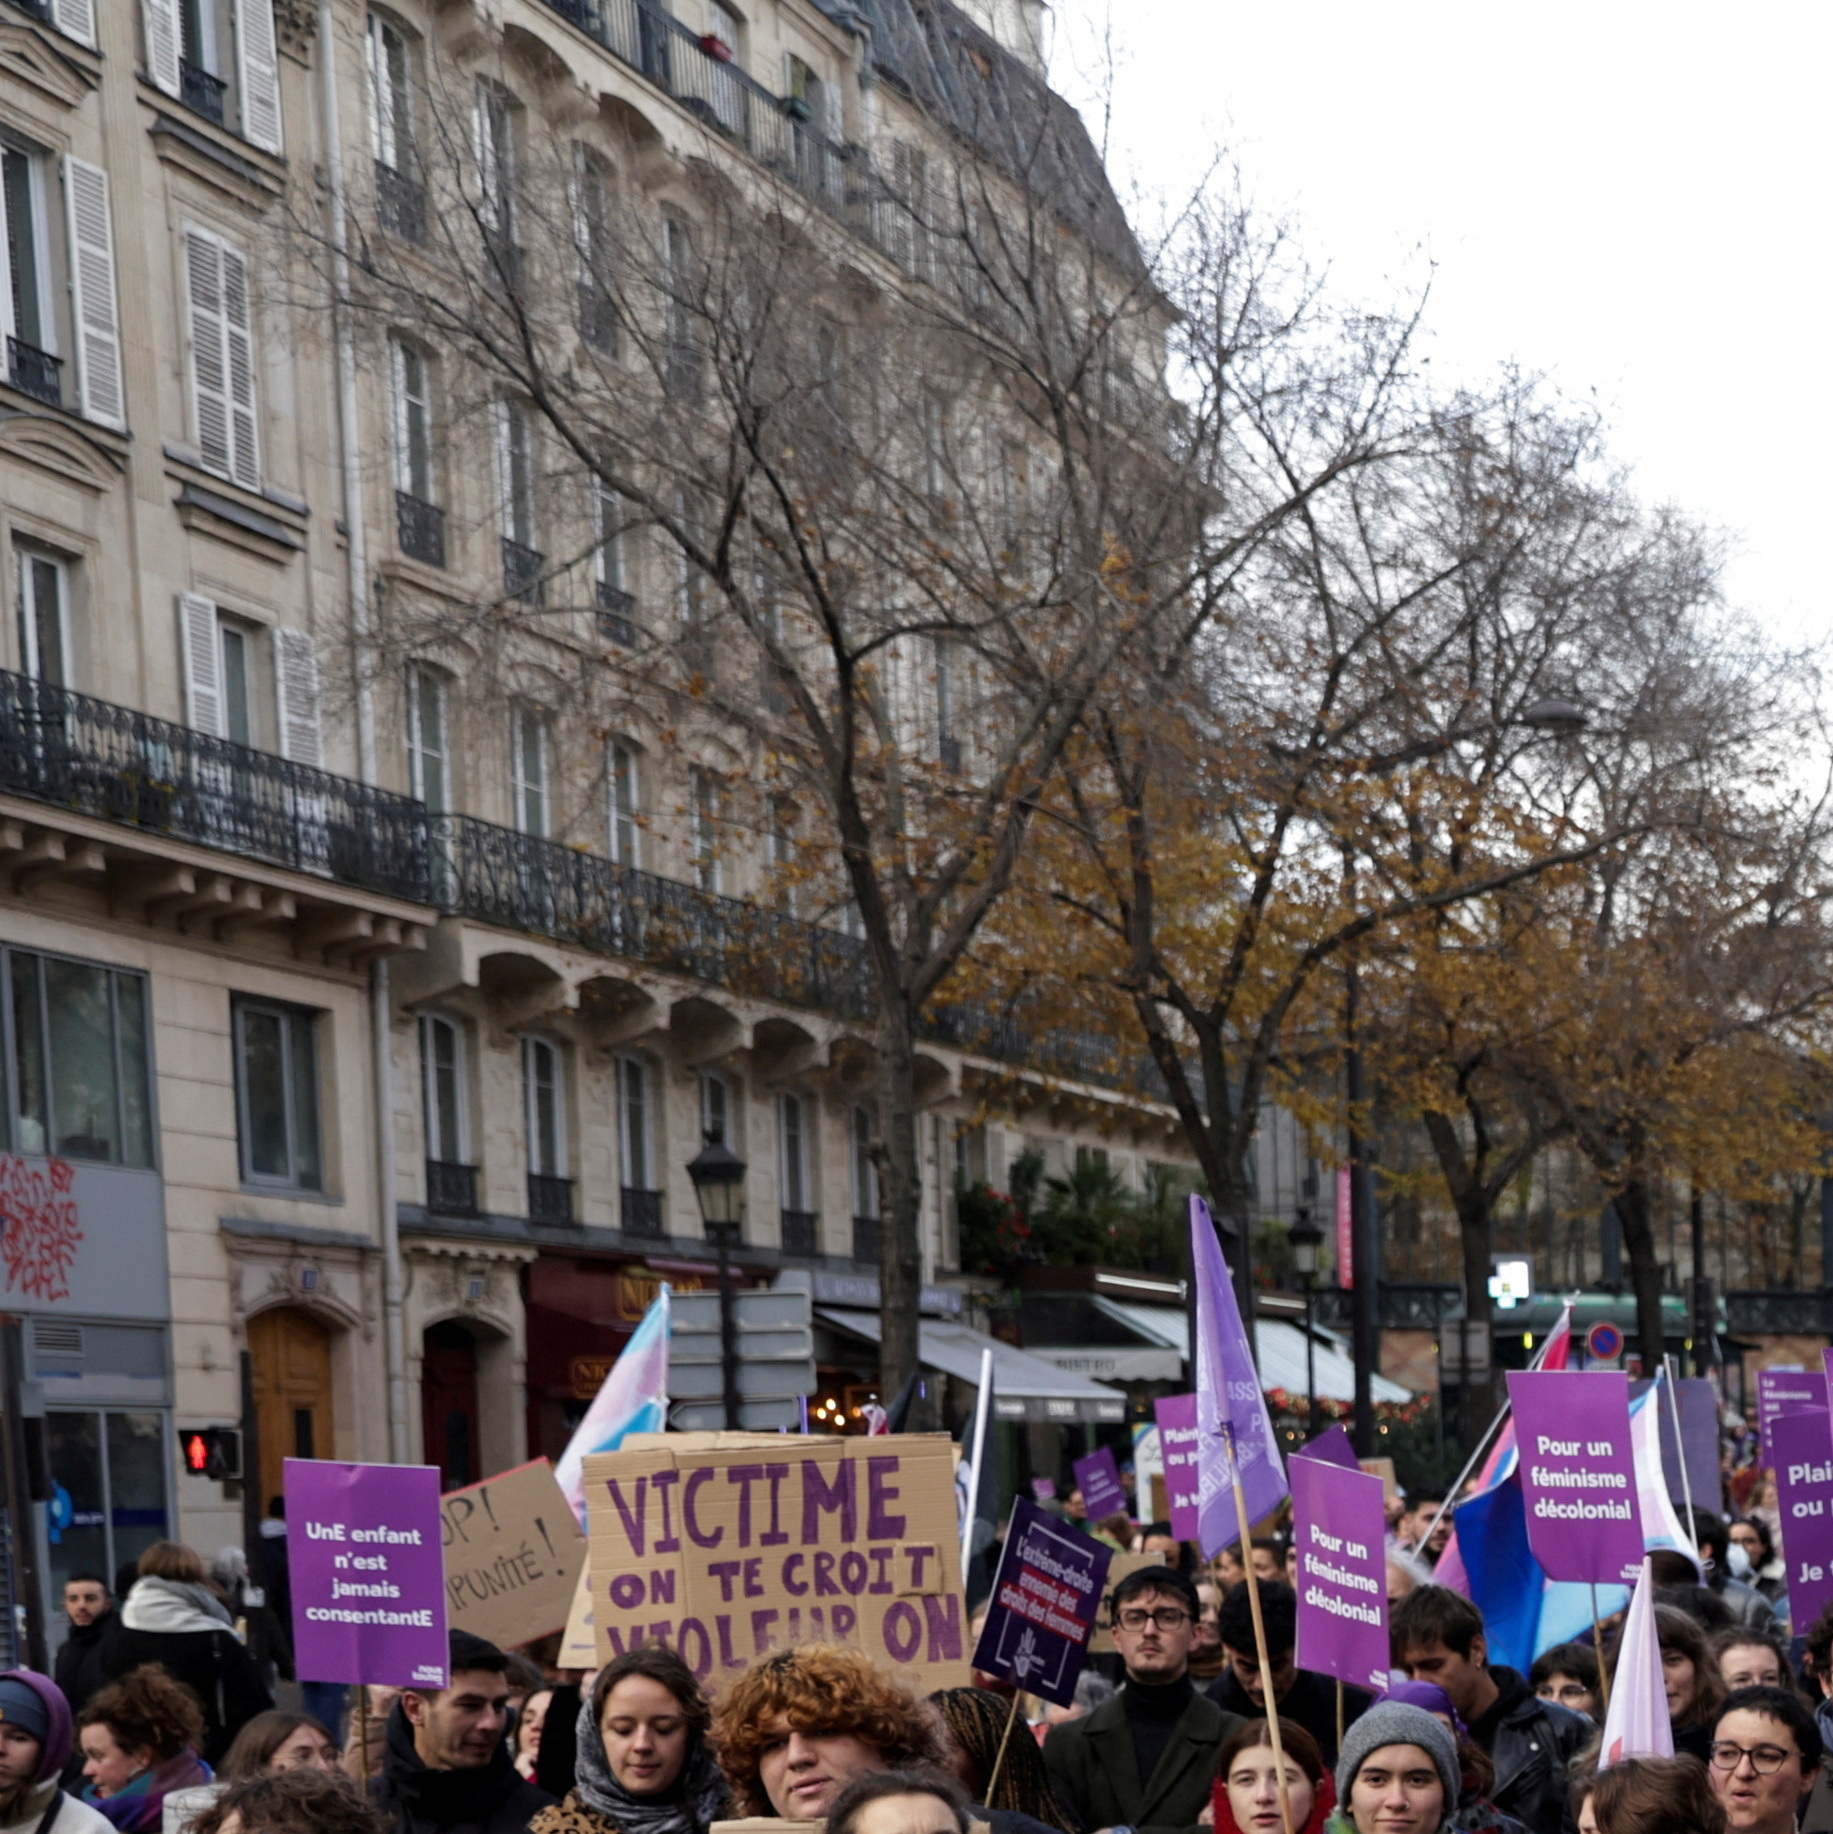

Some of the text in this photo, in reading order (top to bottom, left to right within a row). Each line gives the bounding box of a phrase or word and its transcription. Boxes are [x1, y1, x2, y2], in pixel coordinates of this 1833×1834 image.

[1537, 1435, 1613, 1457] Pour un
[1530, 1466, 1627, 1489] féminisme
[606, 1455, 906, 1557] VICTIME
[1533, 1498, 1632, 1521] décolonial
[1792, 1499, 1824, 1518] ou
[306, 1522, 421, 1545] UnE enfant
[1310, 1524, 1368, 1561] Pour un
[335, 1552, 388, 1571] n'est
[1016, 1535, 1094, 1595] L'extrême-droite
[1799, 1562, 1824, 1584] Je
[609, 1546, 935, 1609] ON TE CROIT
[1304, 1553, 1379, 1595] féminisme
[331, 1578, 400, 1599] jamais
[306, 1607, 433, 1627] consentantE
[1305, 1585, 1382, 1627] décolonial
[882, 1593, 963, 1662] ON
